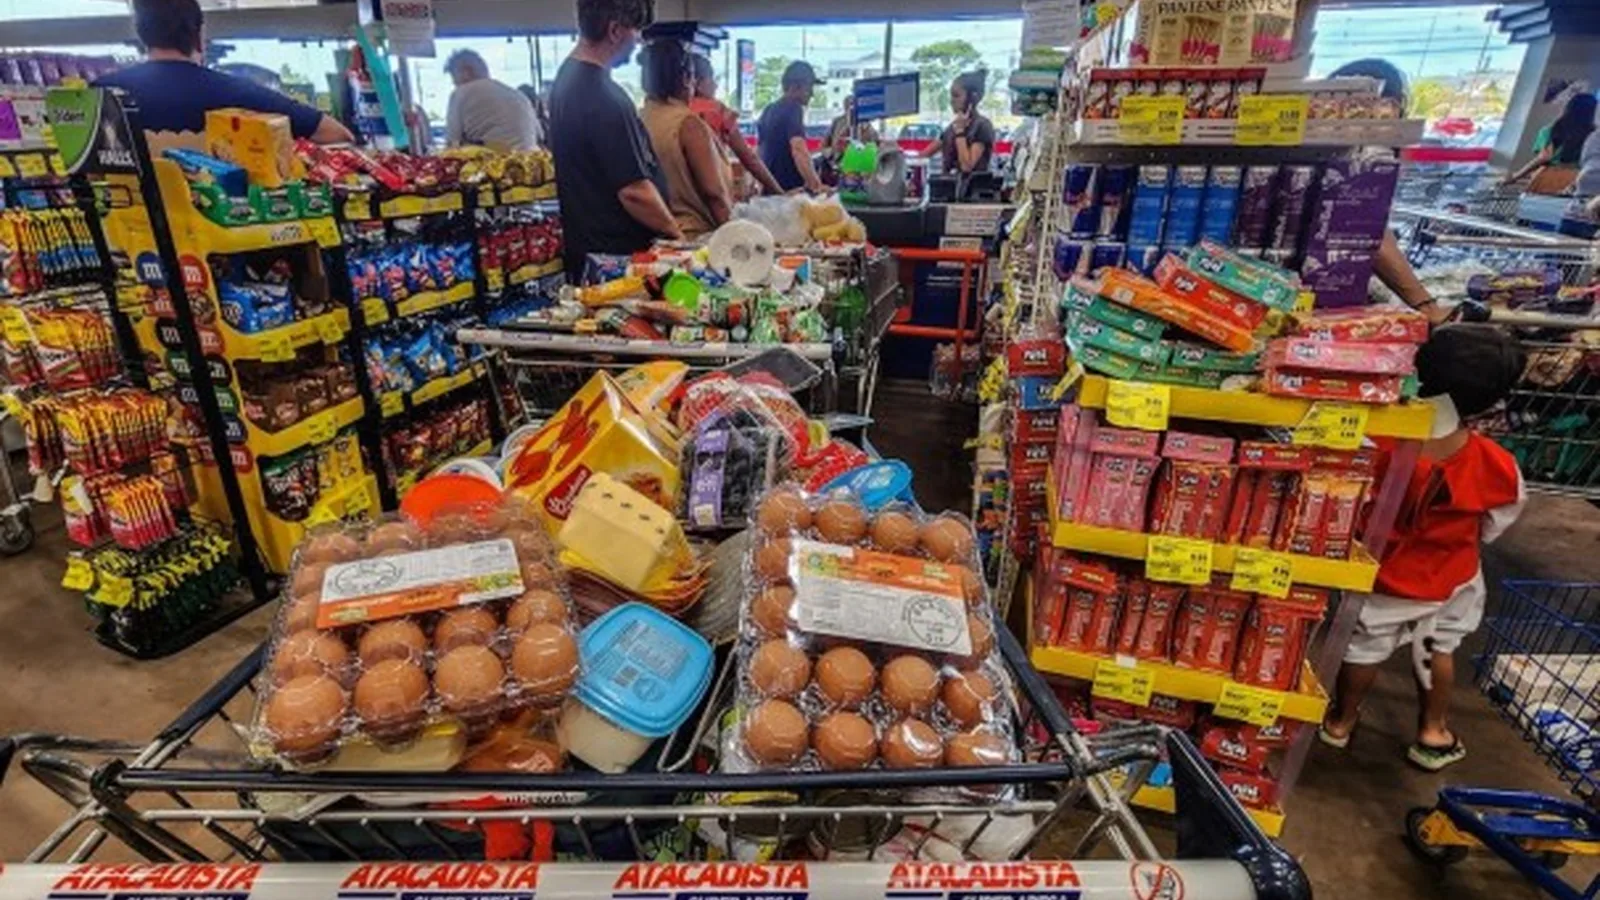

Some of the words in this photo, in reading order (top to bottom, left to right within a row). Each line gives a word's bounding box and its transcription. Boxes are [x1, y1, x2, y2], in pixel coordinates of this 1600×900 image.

[53, 862, 262, 890] ATACADISTA
[339, 862, 540, 889] ATACADISTA
[612, 861, 810, 889] ATACADISTA
[886, 860, 1082, 889] ATACADISTA
